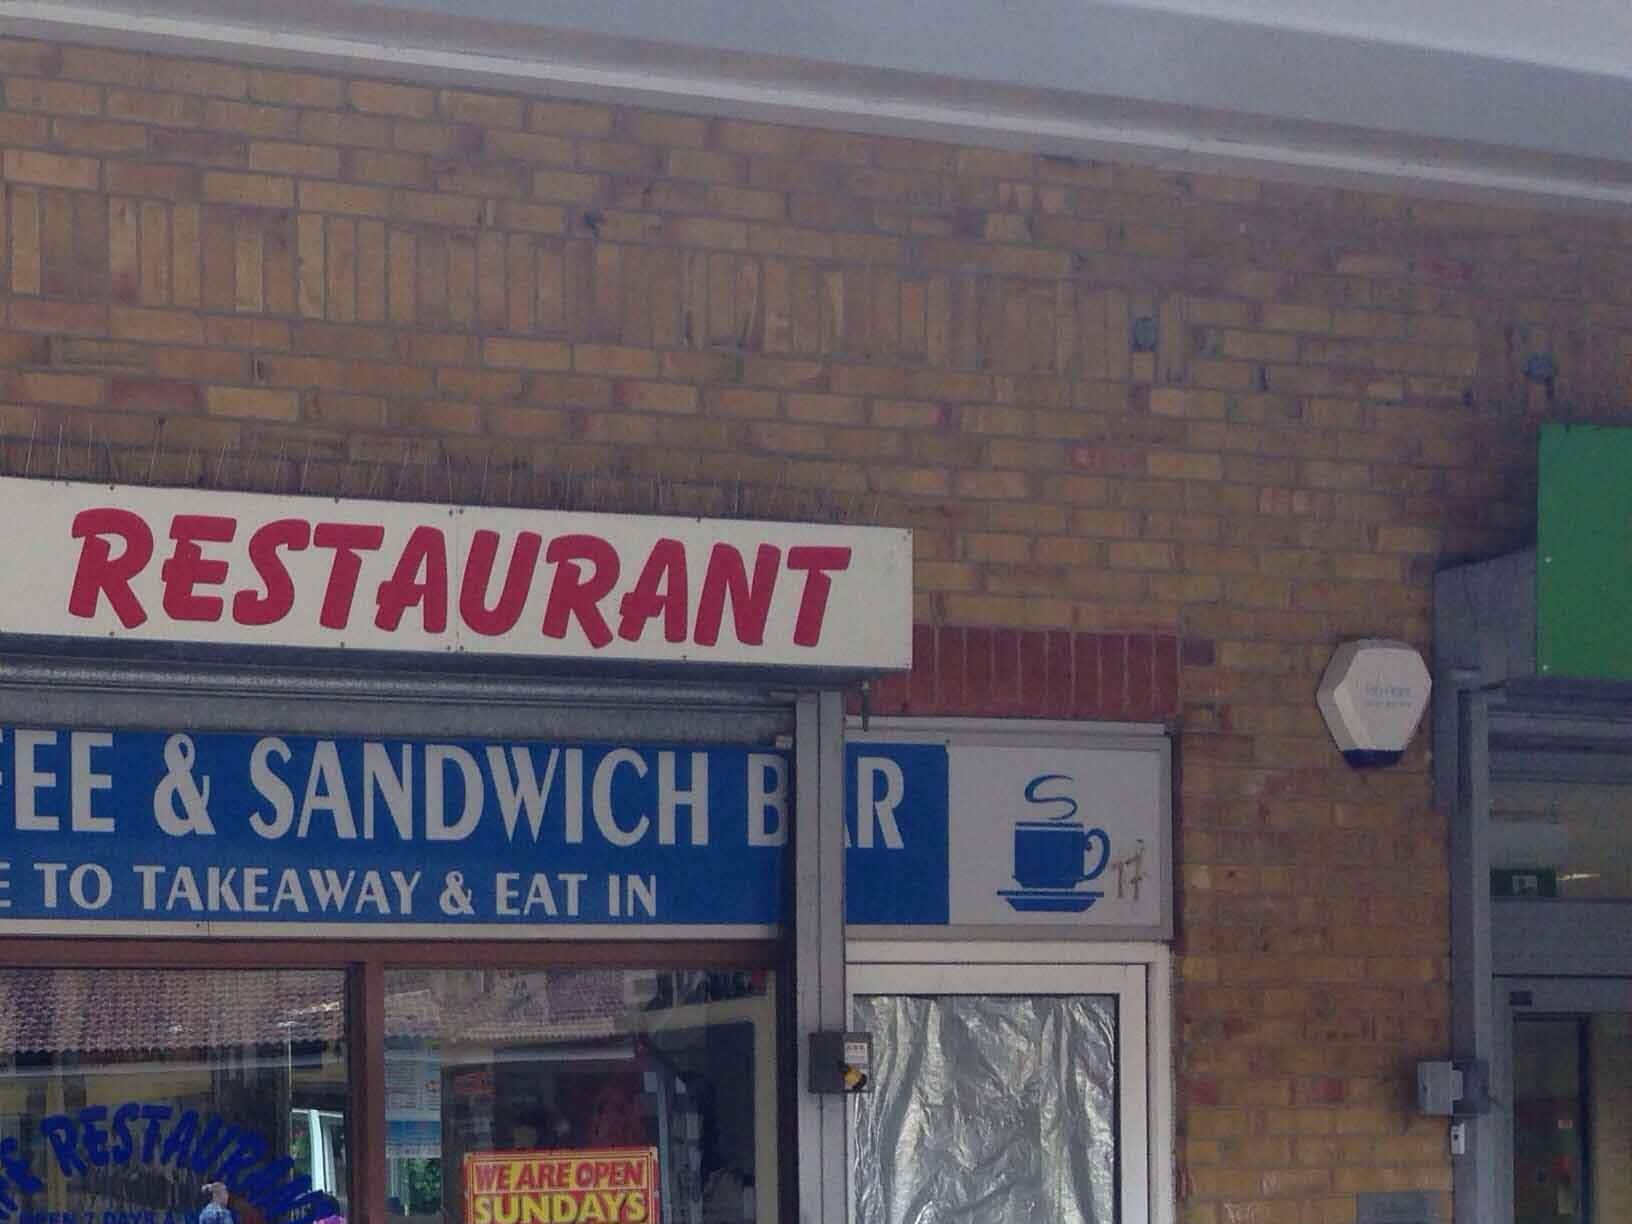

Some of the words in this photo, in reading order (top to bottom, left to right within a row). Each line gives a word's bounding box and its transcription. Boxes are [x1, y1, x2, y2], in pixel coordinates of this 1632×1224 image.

[68, 507, 852, 648] RESTAURANT
[154, 733, 216, 836] &
[248, 736, 709, 847] SANDWICH
[747, 753, 904, 849] BR
[34, 863, 112, 909] TO
[133, 864, 421, 915] TAKEAWAY
[439, 870, 475, 916] &
[496, 872, 587, 916] EAT
[608, 873, 657, 916] IN
[475, 1162, 511, 1193] WE
[517, 1160, 570, 1190] ARE
[575, 1157, 644, 1188] OPEN
